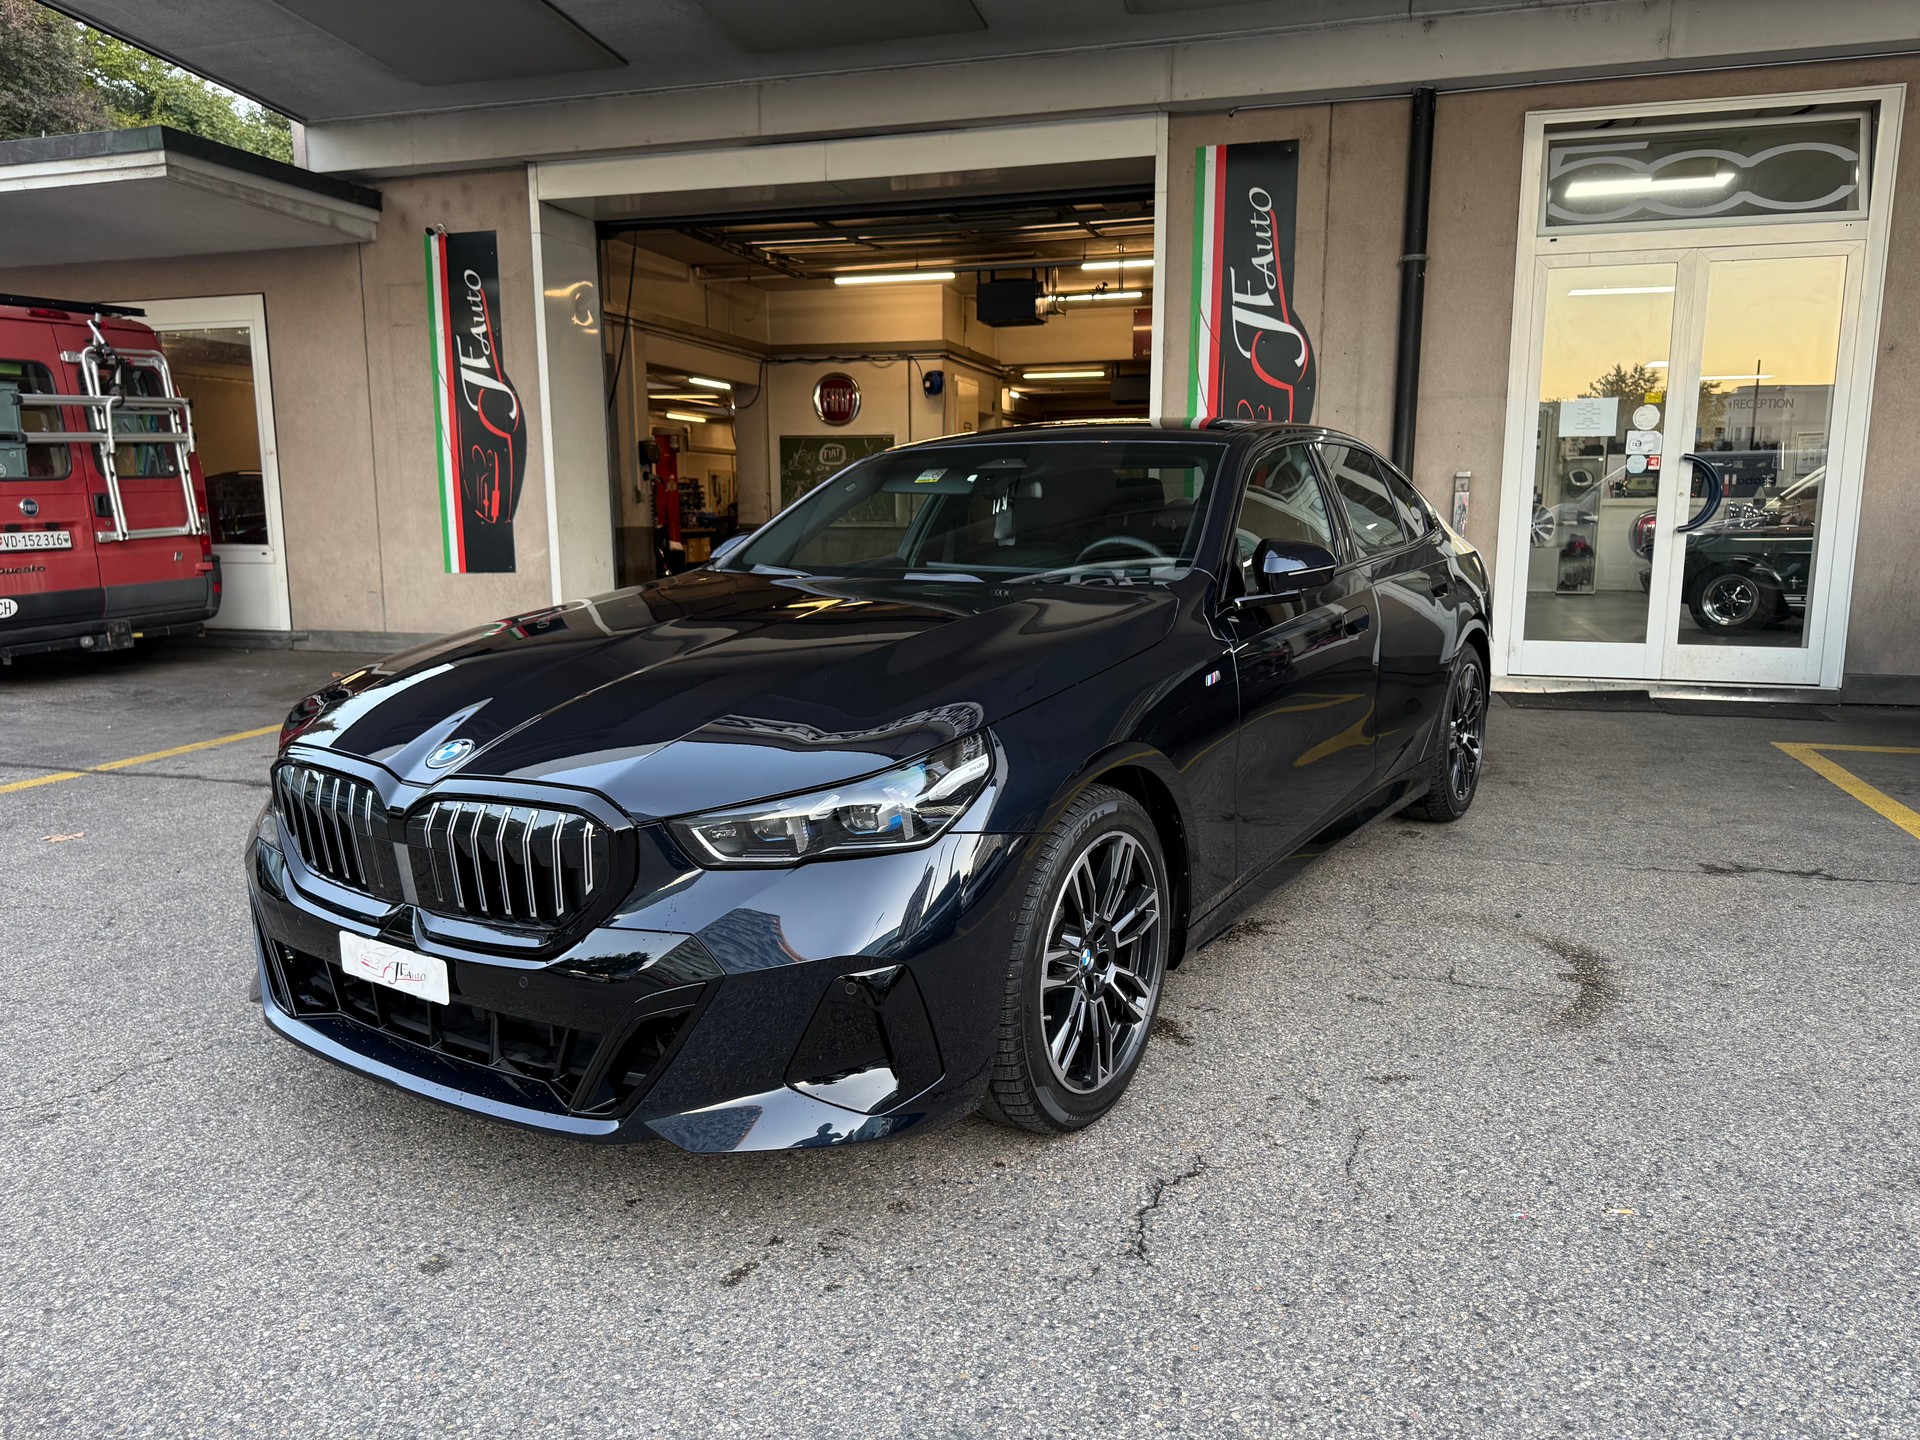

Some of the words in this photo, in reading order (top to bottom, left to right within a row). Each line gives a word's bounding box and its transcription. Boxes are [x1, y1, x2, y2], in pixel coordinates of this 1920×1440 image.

[823, 388, 852, 412] FIAT
[1732, 398, 1795, 410] RECEPTION
[824, 448, 841, 460] FIAT
